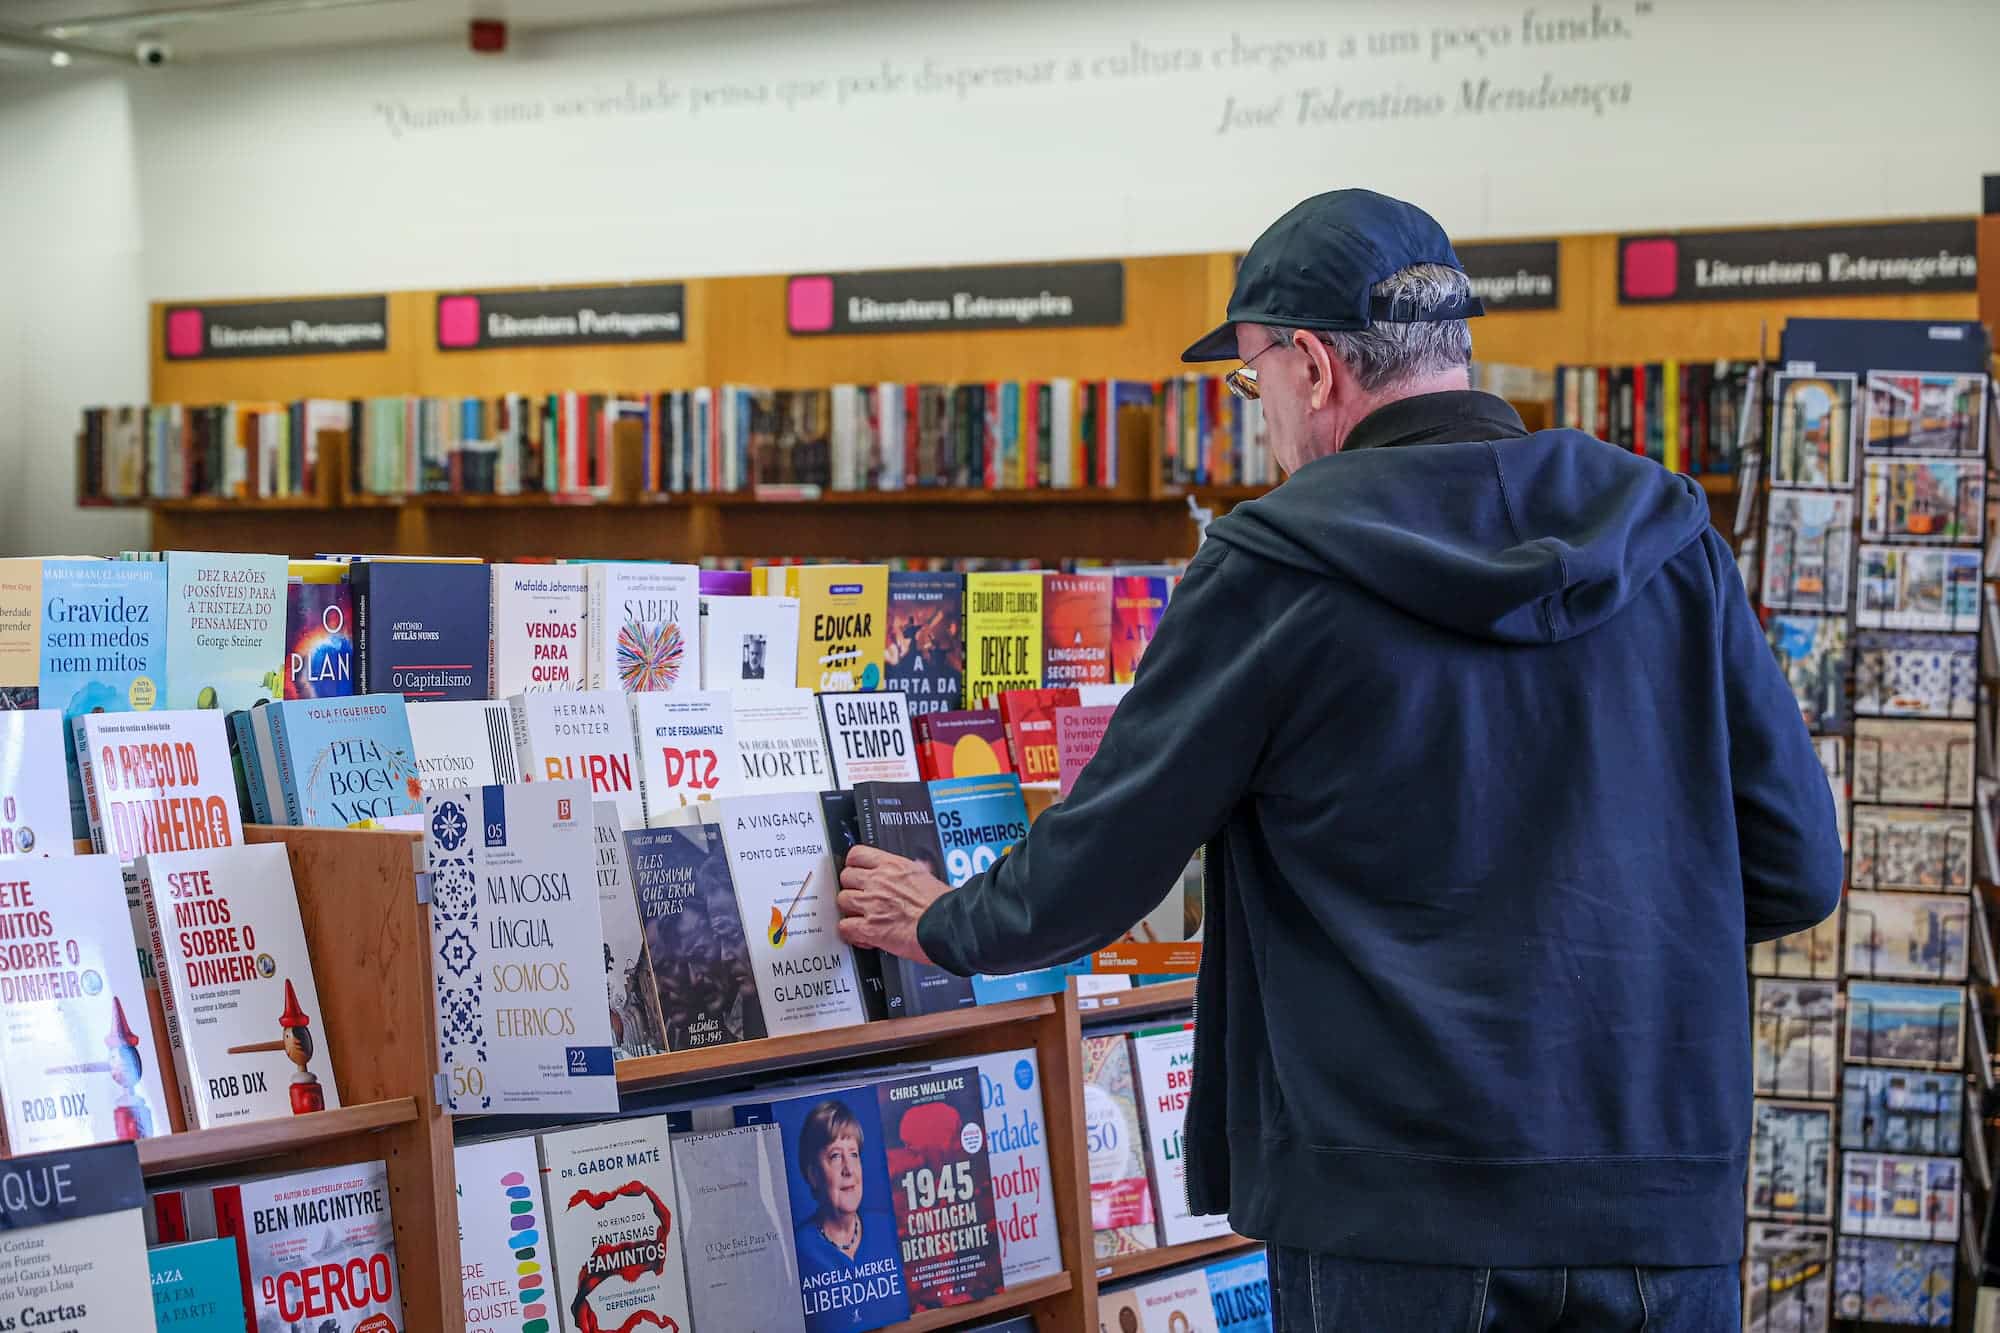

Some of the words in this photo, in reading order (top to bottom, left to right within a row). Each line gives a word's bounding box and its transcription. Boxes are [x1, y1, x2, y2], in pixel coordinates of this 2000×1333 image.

[1092, 37, 1201, 79] cultura
[1213, 32, 1328, 72] chegou
[1338, 34, 1357, 61] a
[1368, 30, 1420, 58] um
[1430, 25, 1512, 62] poço
[1214, 90, 1284, 135] José
[1297, 82, 1447, 127] Tolentino
[1456, 71, 1633, 117] Mendonça
[1696, 258, 1822, 287] Literatura
[1828, 250, 1977, 285] Estrangeira
[848, 295, 951, 322] Literatura
[953, 291, 1073, 322] Estrangeira
[488, 312, 576, 336] Literatura
[578, 307, 679, 336] Portuguesa
[210, 324, 289, 347] Literatura
[198, 570, 220, 583] DEZ
[222, 567, 265, 583] RAZÕES
[515, 579, 548, 592] Mafalda
[550, 580, 588, 593] Johannsen
[183, 582, 248, 600] (POSSÍVEIS)
[249, 585, 276, 600] PARA
[973, 592, 1003, 613] EDUARDO
[47, 597, 149, 623] Gravidez
[188, 604, 195, 614] A
[199, 602, 253, 615] TRISTEZA
[255, 604, 272, 615] DO
[322, 605, 343, 634] O
[624, 600, 679, 622] SABER
[191, 617, 268, 631] PENSAMENTO
[392, 621, 422, 631] ANTÓNIO
[526, 623, 577, 639] VENDAS
[814, 613, 872, 642] EDUCAR
[47, 633, 90, 648] sem
[91, 626, 149, 648] medos
[196, 634, 229, 649] George
[231, 634, 262, 648] Steiner
[392, 631, 416, 641] AVELÃS
[417, 632, 439, 641] NUNES
[1074, 632, 1082, 644] A
[50, 656, 90, 672] nem
[96, 653, 147, 672] mitos
[534, 645, 568, 660] PARA
[914, 656, 924, 671] A
[981, 637, 1012, 676] DEIXE
[1015, 637, 1029, 675] DE
[1048, 648, 1105, 661] LINGUAGEM
[291, 652, 350, 682] PLAN
[532, 665, 569, 682] QUEM
[1048, 665, 1086, 679] SECRETA
[392, 673, 402, 687] O
[405, 671, 471, 691] Capitalismo
[937, 677, 957, 694] DA
[307, 706, 331, 720] YOLA
[334, 704, 388, 717] FIGUEIREDO
[554, 703, 606, 716] HERMAN
[835, 701, 901, 727] GANHAR
[554, 722, 609, 736] PONTZER
[656, 726, 667, 737] KIT
[669, 727, 677, 737] DE
[678, 725, 723, 736] FERRAMENTAS
[738, 740, 750, 751] NA
[752, 739, 775, 750] HORA
[777, 738, 789, 748] DA
[791, 737, 818, 748] MINHA
[840, 729, 905, 759] TEMPO
[102, 745, 117, 790] O
[119, 742, 176, 796] PREÇO
[176, 741, 199, 787] DO
[416, 753, 474, 773] ANTÓNIO
[741, 750, 823, 779] MORTE
[330, 768, 394, 796] BOCA
[110, 795, 232, 863] DINHEIRO
[737, 818, 746, 830] A
[749, 811, 814, 829] VINGANÇA
[879, 811, 903, 826] PONTO
[904, 810, 934, 825] FINAL
[938, 810, 961, 828] OS
[488, 823, 503, 839] 05
[942, 822, 1027, 849] PRIMEIROS
[637, 853, 663, 871] ELES
[740, 848, 773, 861] PONTO
[775, 847, 786, 858] DE
[789, 844, 823, 856] VIRAGEM
[640, 867, 692, 886] PENSAVAM
[946, 844, 997, 888] 90
[141, 878, 151, 901] SETE
[168, 870, 213, 899] SETE
[487, 876, 506, 905] NA
[510, 873, 571, 904] NOSSA
[642, 885, 664, 902] QUE
[668, 882, 695, 899] ERAM
[145, 900, 159, 929] MITOS
[174, 898, 231, 929] MITOS
[647, 899, 683, 918] LIVRES
[151, 929, 165, 960] SOBRE
[180, 930, 240, 959] SOBRE
[243, 925, 256, 950] O
[0, 940, 62, 971] SOBRE
[66, 939, 80, 967] O
[772, 954, 841, 977] MALCOLM
[493, 962, 570, 993] SOMOS
[159, 970, 174, 1011] DINHEIRO
[774, 978, 850, 1003] GLADWELL
[168, 1015, 178, 1035] ROB
[496, 1007, 576, 1038] ETERNOS
[690, 1031, 722, 1046] 1933-1945
[570, 1050, 587, 1067] 22
[209, 1076, 239, 1100] ROB
[242, 1071, 267, 1096] DIX
[453, 1066, 484, 1097] 50
[889, 1085, 919, 1102] CHRIS
[920, 1077, 965, 1096] WALLACE
[22, 1097, 56, 1124] ROB
[61, 1092, 88, 1118] DIX
[988, 1108, 1040, 1154] rdade
[561, 1169, 576, 1179] DR.
[578, 1156, 624, 1175] GABOR
[627, 1146, 660, 1168] MATÉ
[902, 1160, 975, 1212] 1945
[254, 1206, 289, 1235] BEN
[294, 1189, 383, 1229] MACINTYRE
[597, 1219, 609, 1228] NO
[610, 1215, 630, 1225] REINO
[632, 1212, 645, 1221] DOS
[907, 1201, 977, 1237] CONTAGEM
[592, 1225, 654, 1248] FANTASMAS
[998, 1202, 1039, 1258] yder
[4, 1238, 44, 1252] Cortázar
[902, 1223, 989, 1263] DECRESCENTE
[14, 1255, 51, 1267] Fuentes
[588, 1242, 666, 1274] FAMINTOS
[20, 1266, 50, 1283] García
[53, 1261, 93, 1276] Márquez
[802, 1268, 852, 1290] ANGELA
[854, 1258, 897, 1280] MERKEL
[17, 1282, 48, 1298] Vargas
[50, 1279, 74, 1293] Llosa
[276, 1252, 393, 1323] CERCO
[802, 1274, 901, 1316] LIBERDADE
[606, 1293, 656, 1311] DEPENDÊNCIA
[21, 1304, 87, 1328] Cartas
